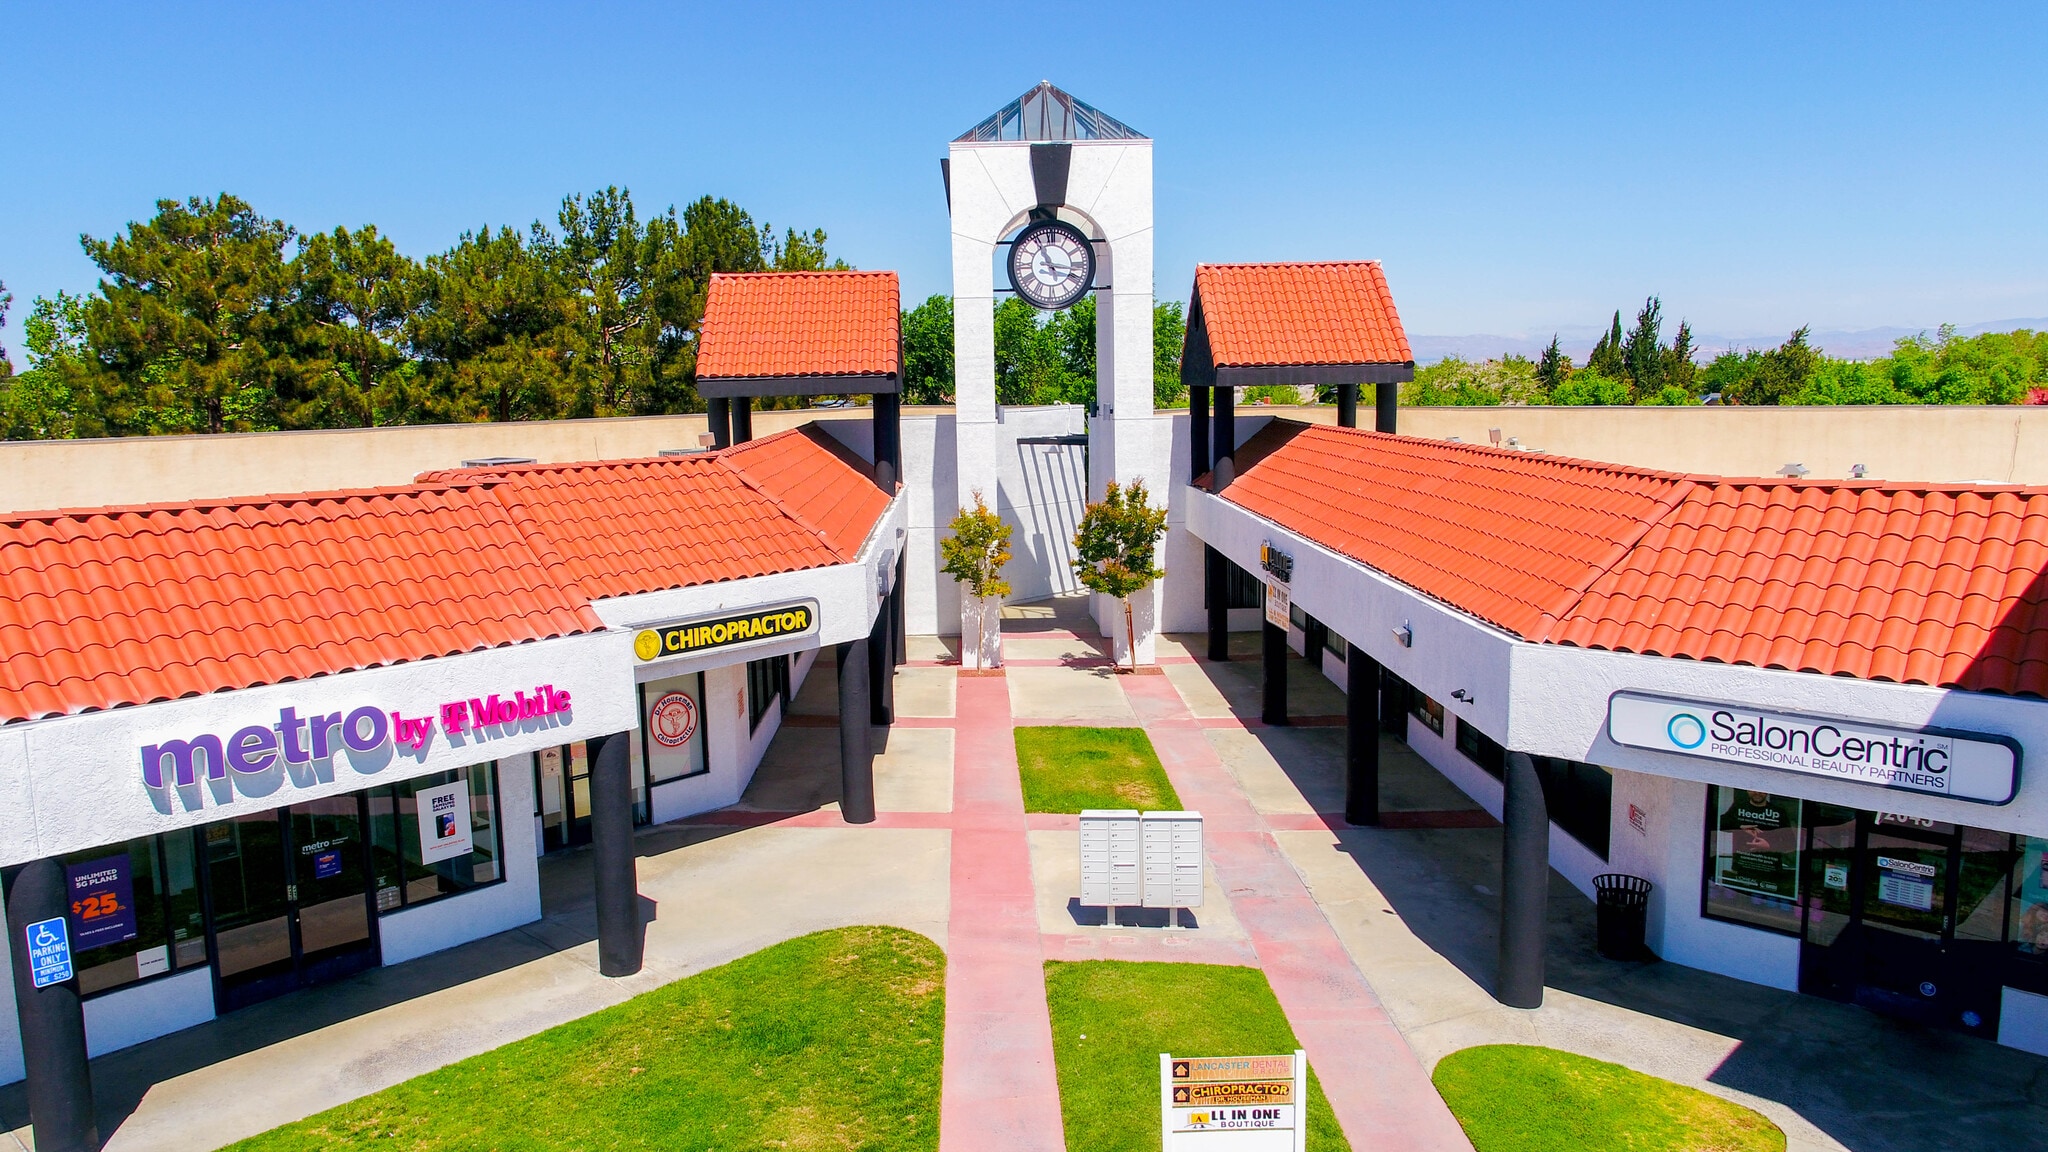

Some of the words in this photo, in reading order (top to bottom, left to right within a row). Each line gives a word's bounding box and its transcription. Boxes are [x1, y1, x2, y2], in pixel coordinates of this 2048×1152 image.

[665, 610, 807, 651] CHIROPRACTOR
[661, 696, 693, 710] Houseman
[657, 726, 694, 744] Chiropractic
[1710, 710, 1948, 774] SalonCentric
[141, 706, 388, 789] metro
[390, 711, 434, 750] by
[1711, 743, 1809, 768] PROFESSIONAL
[1812, 758, 1866, 776] BEAUTY
[1869, 766, 1945, 788] PARTNERS
[432, 793, 455, 804] FREE
[302, 840, 330, 852] metro
[1888, 858, 1934, 874] SalonCentric
[75, 868, 118, 882] UNLIMITED
[76, 880, 88, 889] 5G
[90, 874, 118, 886] PLANS
[72, 892, 118, 920] $25
[32, 942, 66, 958] PARKING
[40, 954, 61, 966] ONLY
[37, 976, 50, 984] FINE
[54, 970, 70, 980] $250
[40, 964, 64, 976] MINIMUM
[1192, 1062, 1250, 1071] LANCASTER
[1252, 1060, 1289, 1069] DENTAL
[1192, 1084, 1288, 1098] CHIROPRACTOR
[1232, 1110, 1246, 1120] IN
[1252, 1108, 1281, 1120] ONE
[1220, 1120, 1274, 1128] BOUTIQUE
